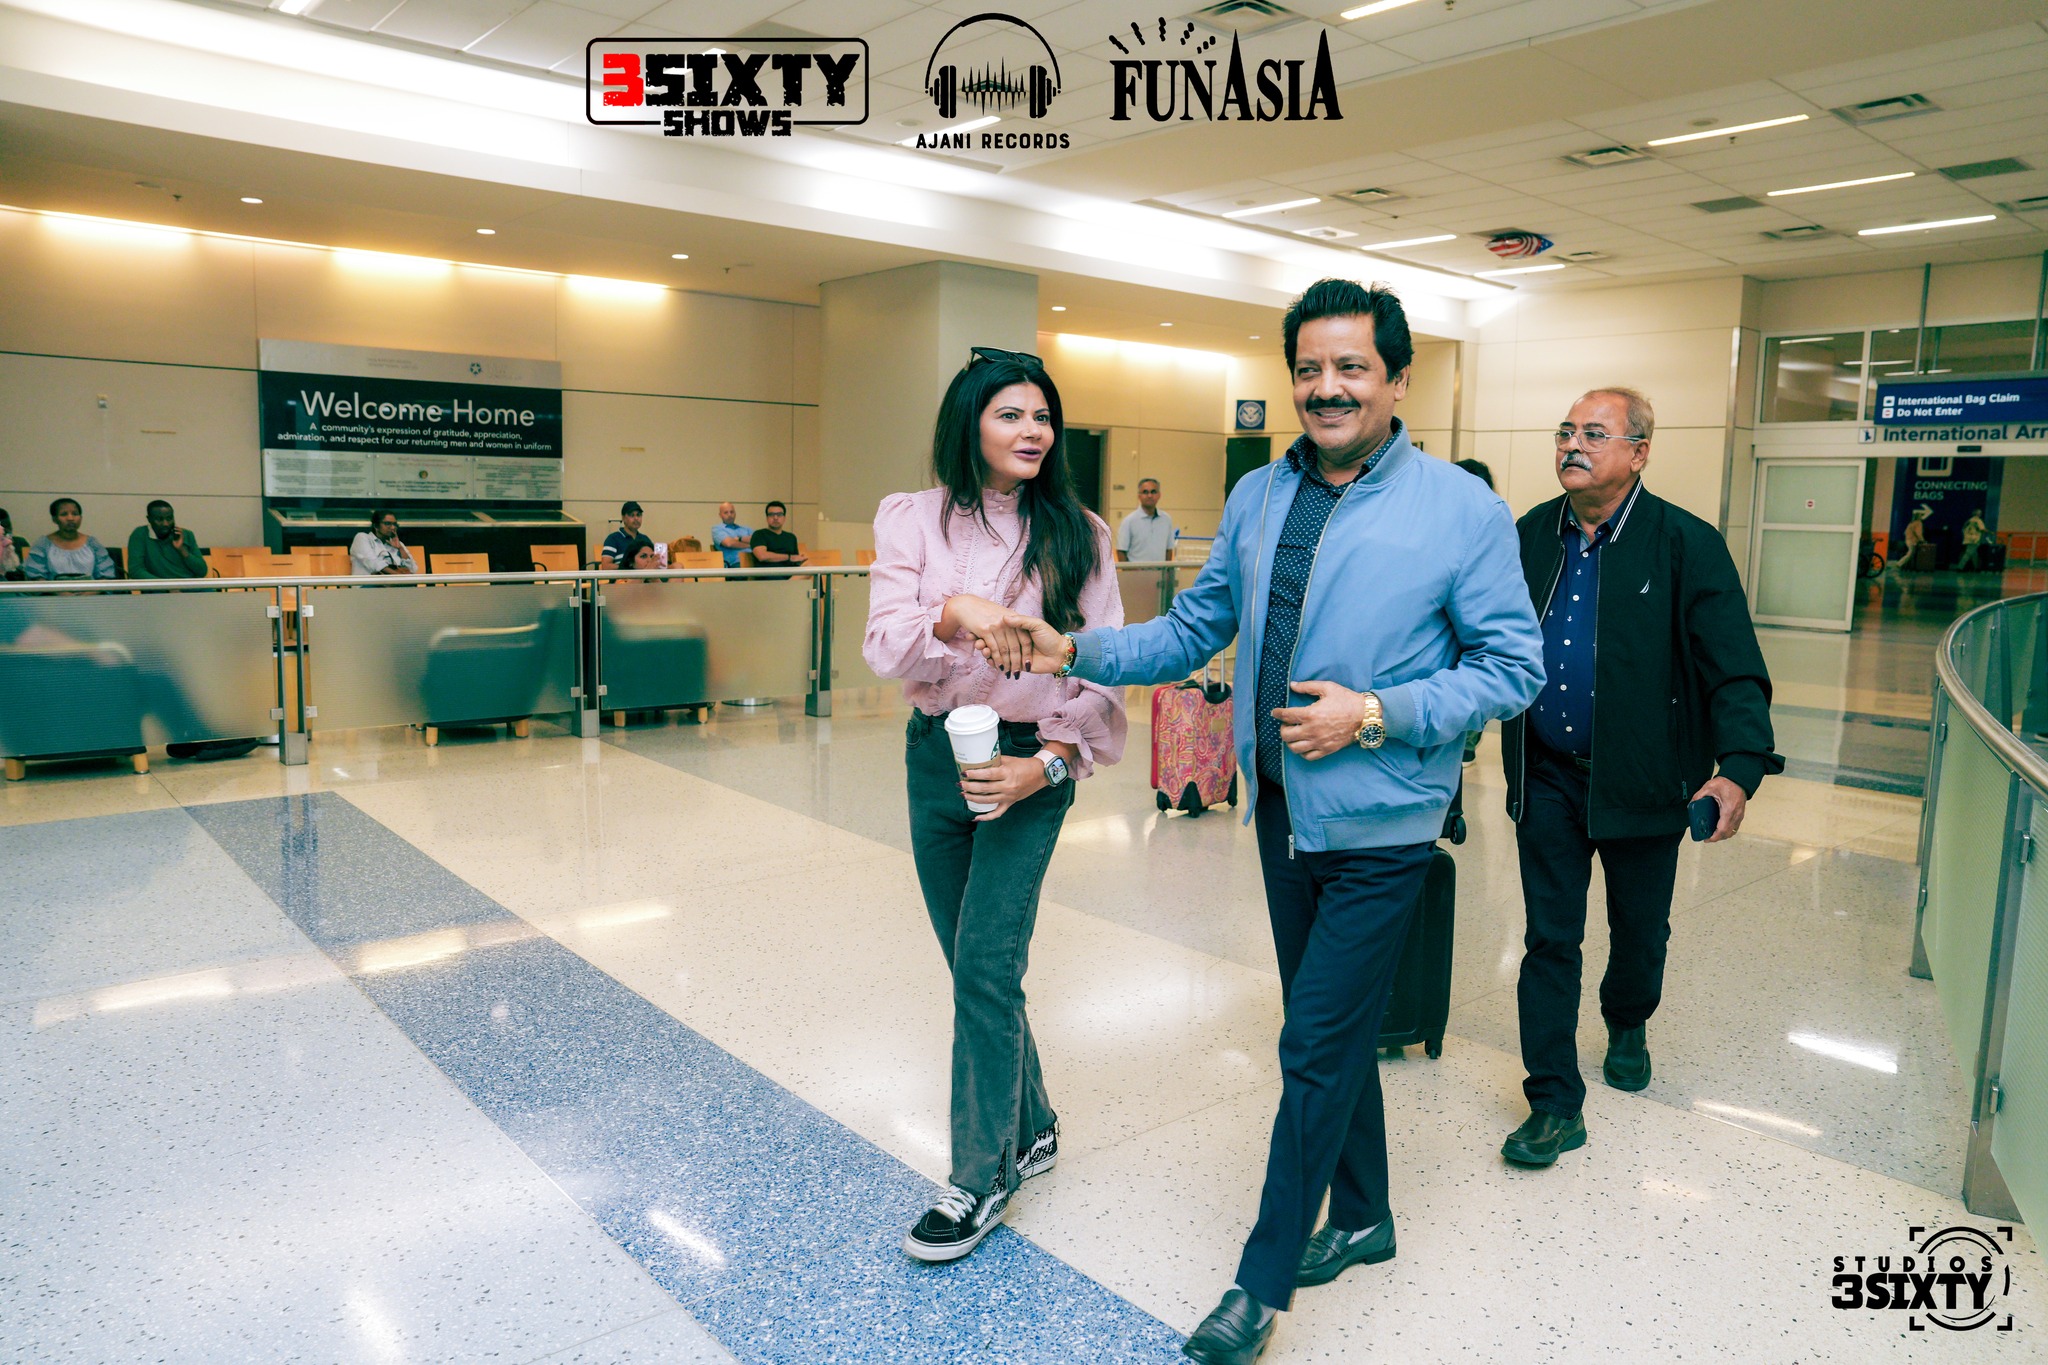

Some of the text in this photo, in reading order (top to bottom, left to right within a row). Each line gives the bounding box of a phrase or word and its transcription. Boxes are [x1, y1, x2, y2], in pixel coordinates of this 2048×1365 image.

[1898, 393, 2020, 406] International Bag Claim
[300, 390, 535, 427] Welcome Home
[1896, 406, 1963, 417] Do Not Enter
[309, 422, 523, 440] A community's expression of gratitude, appreciation,
[1883, 425, 2008, 442] International
[277, 431, 327, 443] admiration,
[329, 433, 346, 443] and
[348, 435, 379, 446] respect
[381, 435, 393, 445] for
[395, 437, 409, 445] our
[411, 439, 448, 449] returning
[450, 440, 467, 448] men
[469, 440, 484, 448] and
[514, 441, 522, 449] in
[523, 442, 552, 450] uniform
[1914, 481, 1988, 491] CONNECTING
[1914, 491, 1944, 500] BAGS
